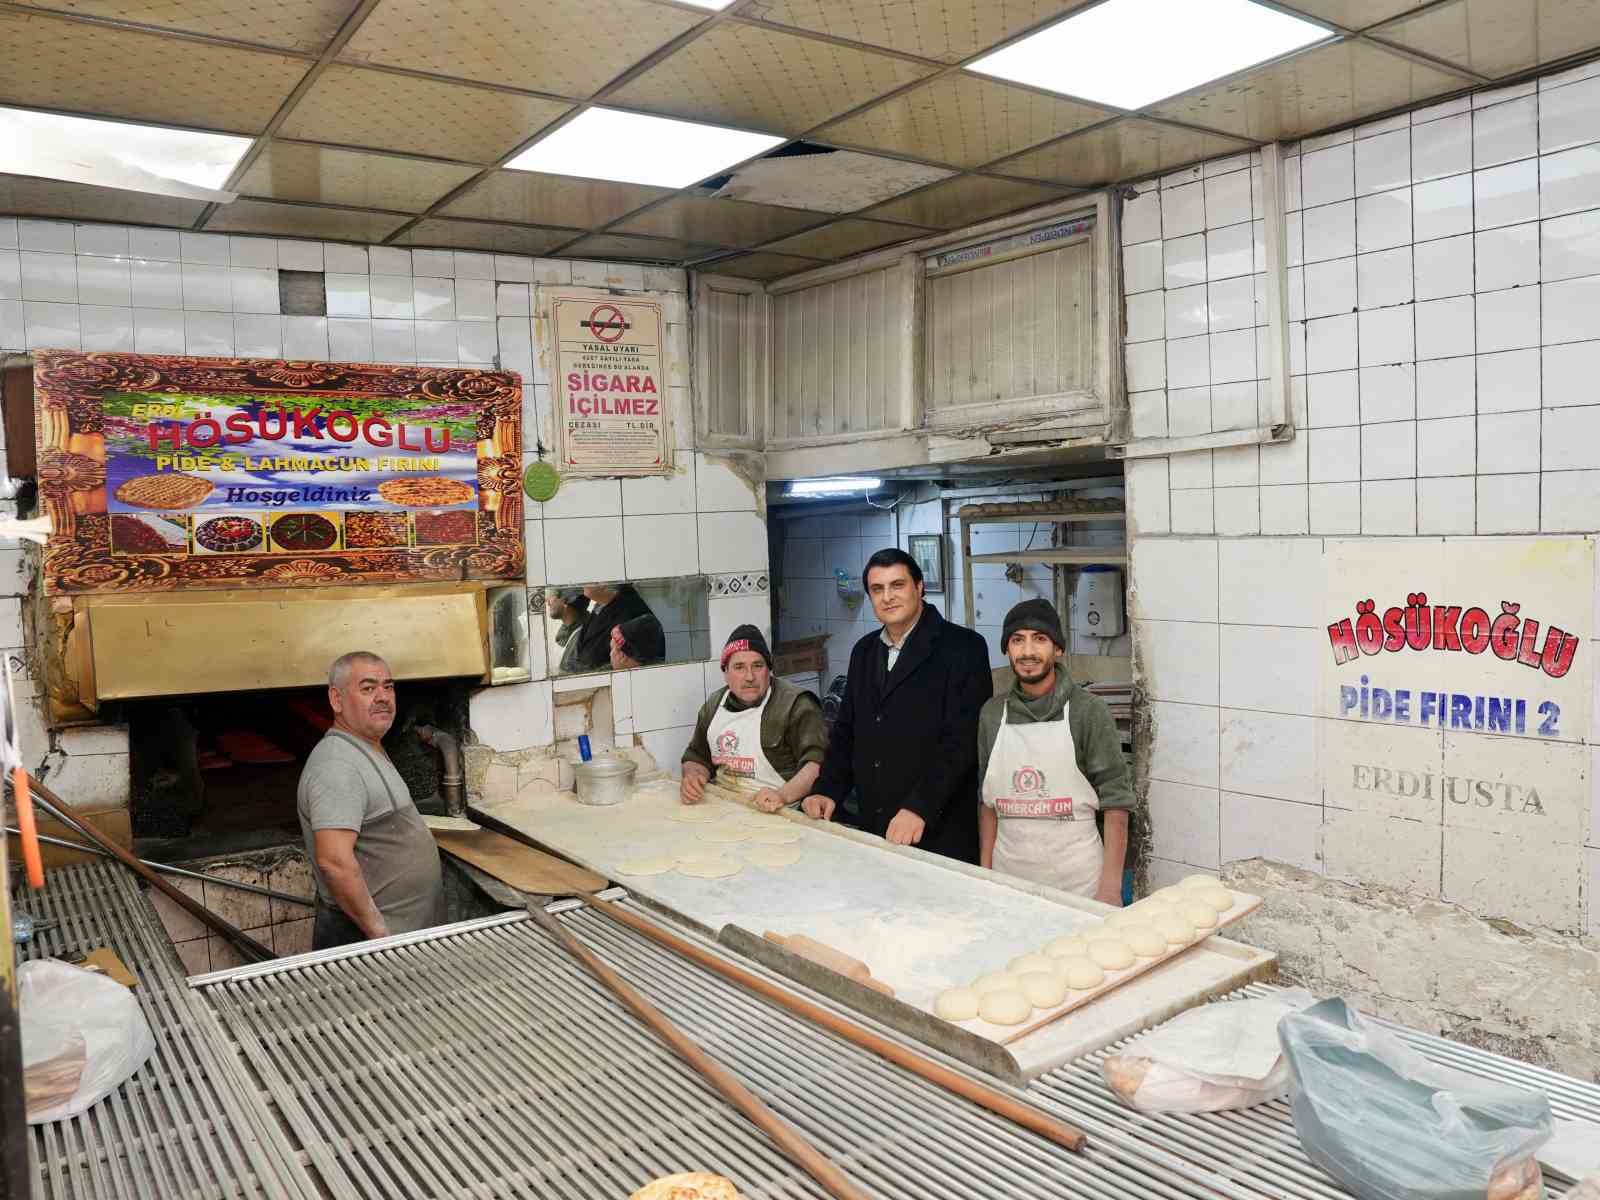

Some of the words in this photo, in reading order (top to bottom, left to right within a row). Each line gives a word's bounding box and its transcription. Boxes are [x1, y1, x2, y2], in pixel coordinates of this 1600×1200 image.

[583, 344, 611, 353] YASAL
[613, 345, 640, 353] UYARI
[567, 370, 657, 393] SİGARA
[569, 393, 659, 418] İÇİLMEZ
[148, 400, 451, 454] HÖSÜKOĞLU
[568, 421, 601, 429] CEZASI
[156, 454, 212, 471] PİDE
[219, 456, 236, 471] &
[244, 455, 369, 472] LAHMACUN
[377, 456, 440, 472] FIRINI
[225, 486, 372, 507] Hoşgeldiniz
[1328, 592, 1579, 678] HÖSÜKOĞLU
[1340, 674, 1411, 722] PİDE
[1420, 690, 1527, 734] FIRINI
[1537, 701, 1561, 736] 2
[1352, 762, 1435, 801] ERDİ
[1443, 774, 1547, 816] USTA
